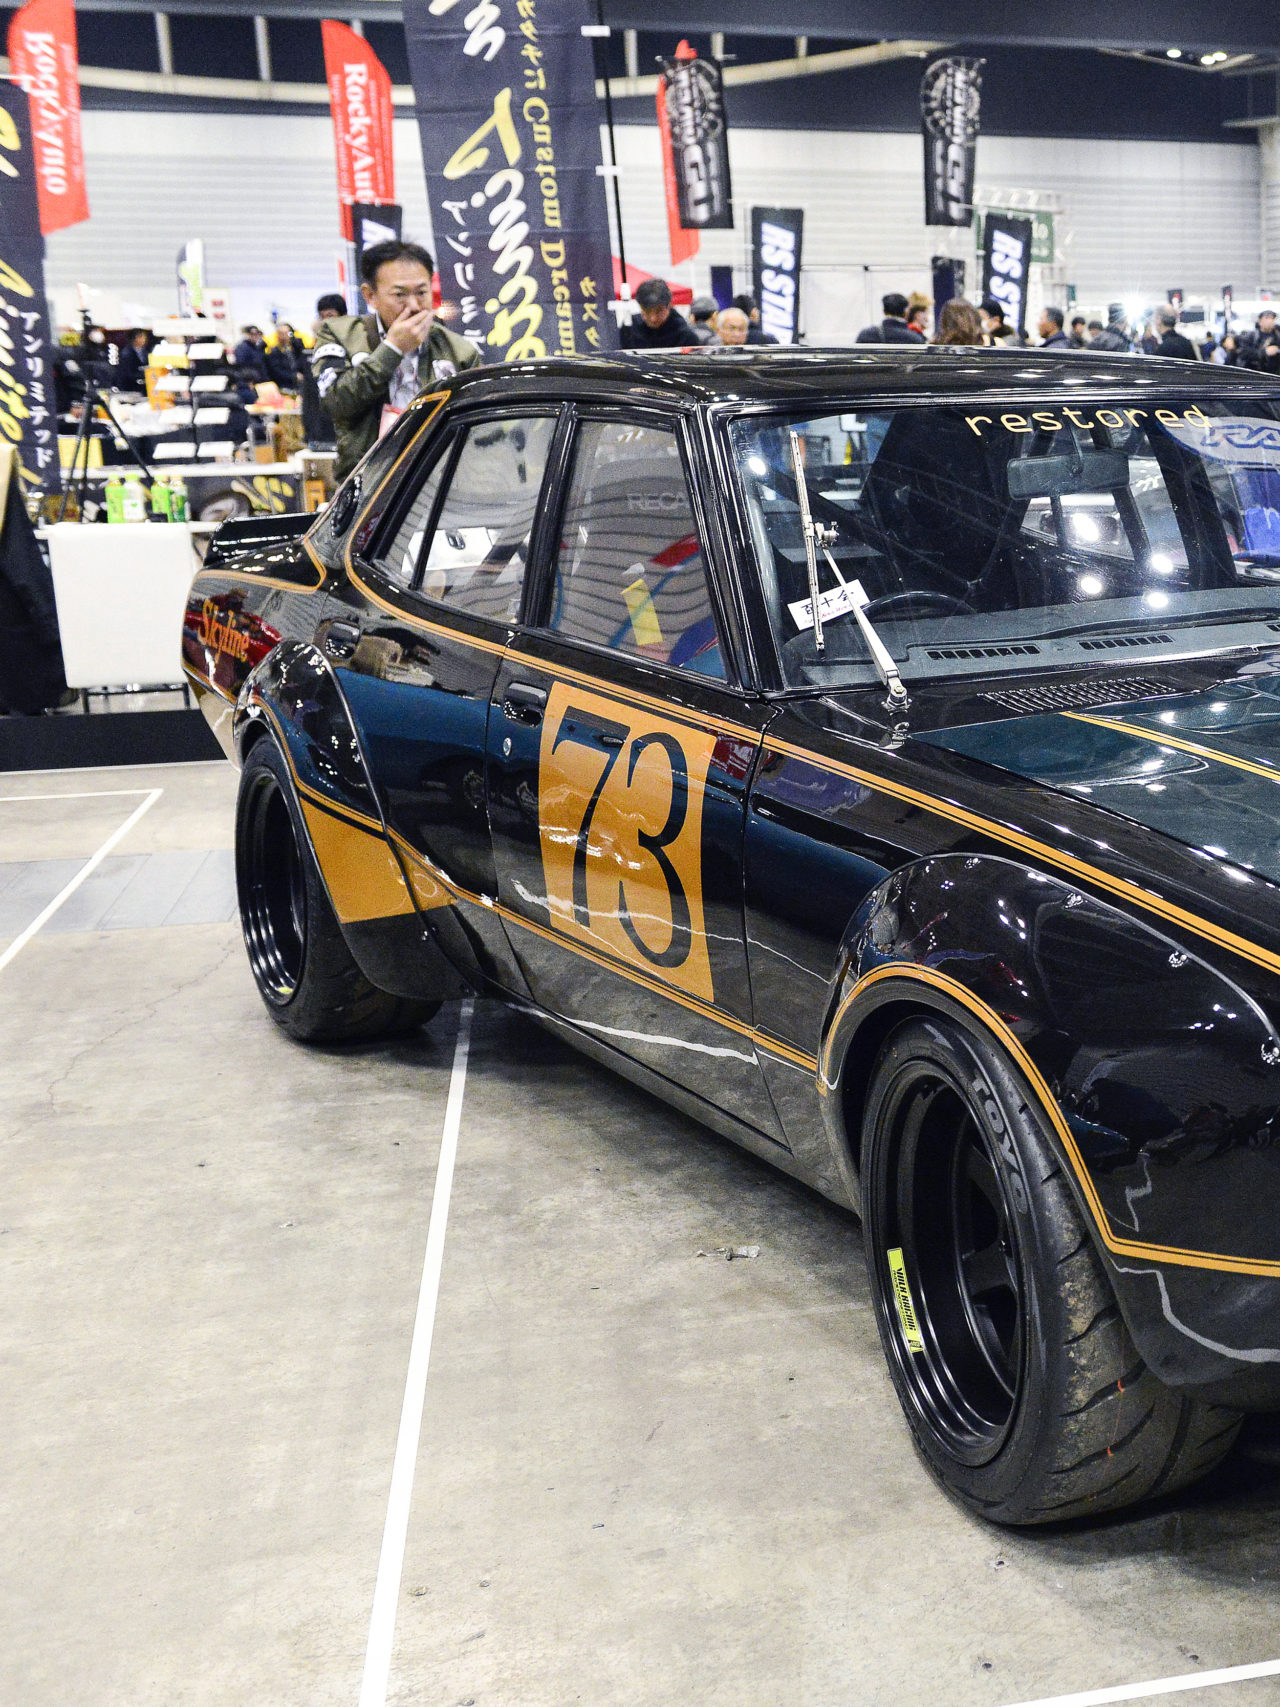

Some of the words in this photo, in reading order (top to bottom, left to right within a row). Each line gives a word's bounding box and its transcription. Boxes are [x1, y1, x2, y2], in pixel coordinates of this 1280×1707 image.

[761, 222, 795, 271] RS
[991, 229, 1023, 279] RS
[964, 404, 1214, 436] restored
[197, 598, 250, 664] Skyline
[551, 704, 693, 969] 73
[972, 1073, 1028, 1215] TOYO
